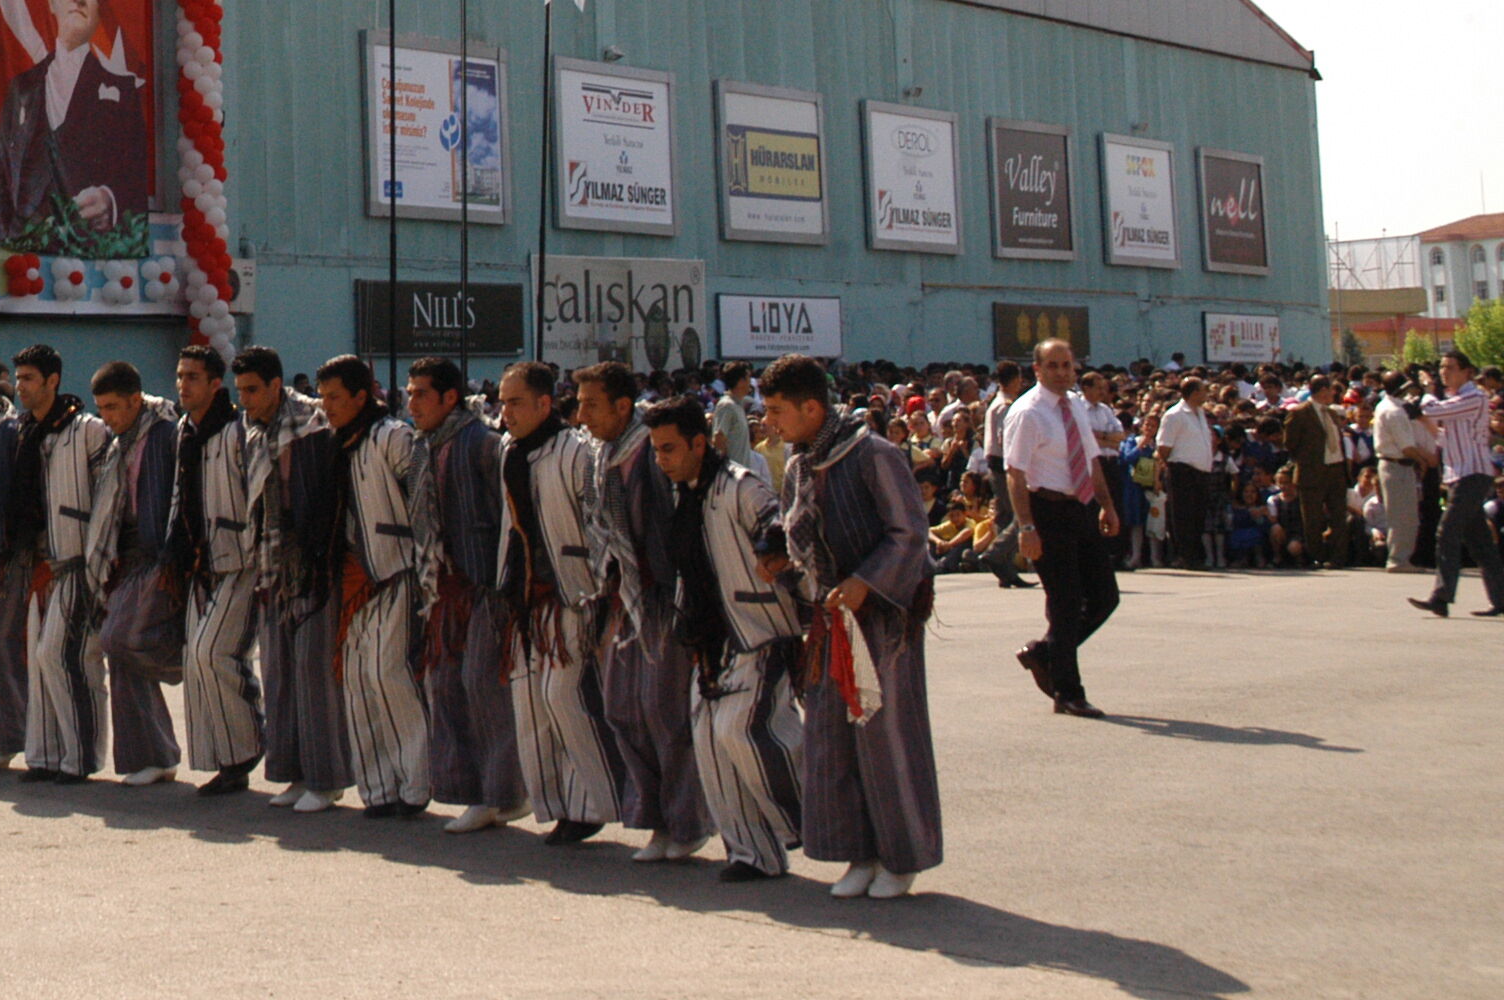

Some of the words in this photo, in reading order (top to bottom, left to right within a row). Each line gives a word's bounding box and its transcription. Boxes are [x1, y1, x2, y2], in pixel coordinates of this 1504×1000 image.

[1004, 153, 1056, 206] Valley
[584, 180, 624, 202] YILMAZ
[627, 182, 667, 206] SÜNGER
[1013, 206, 1058, 228] Furniture
